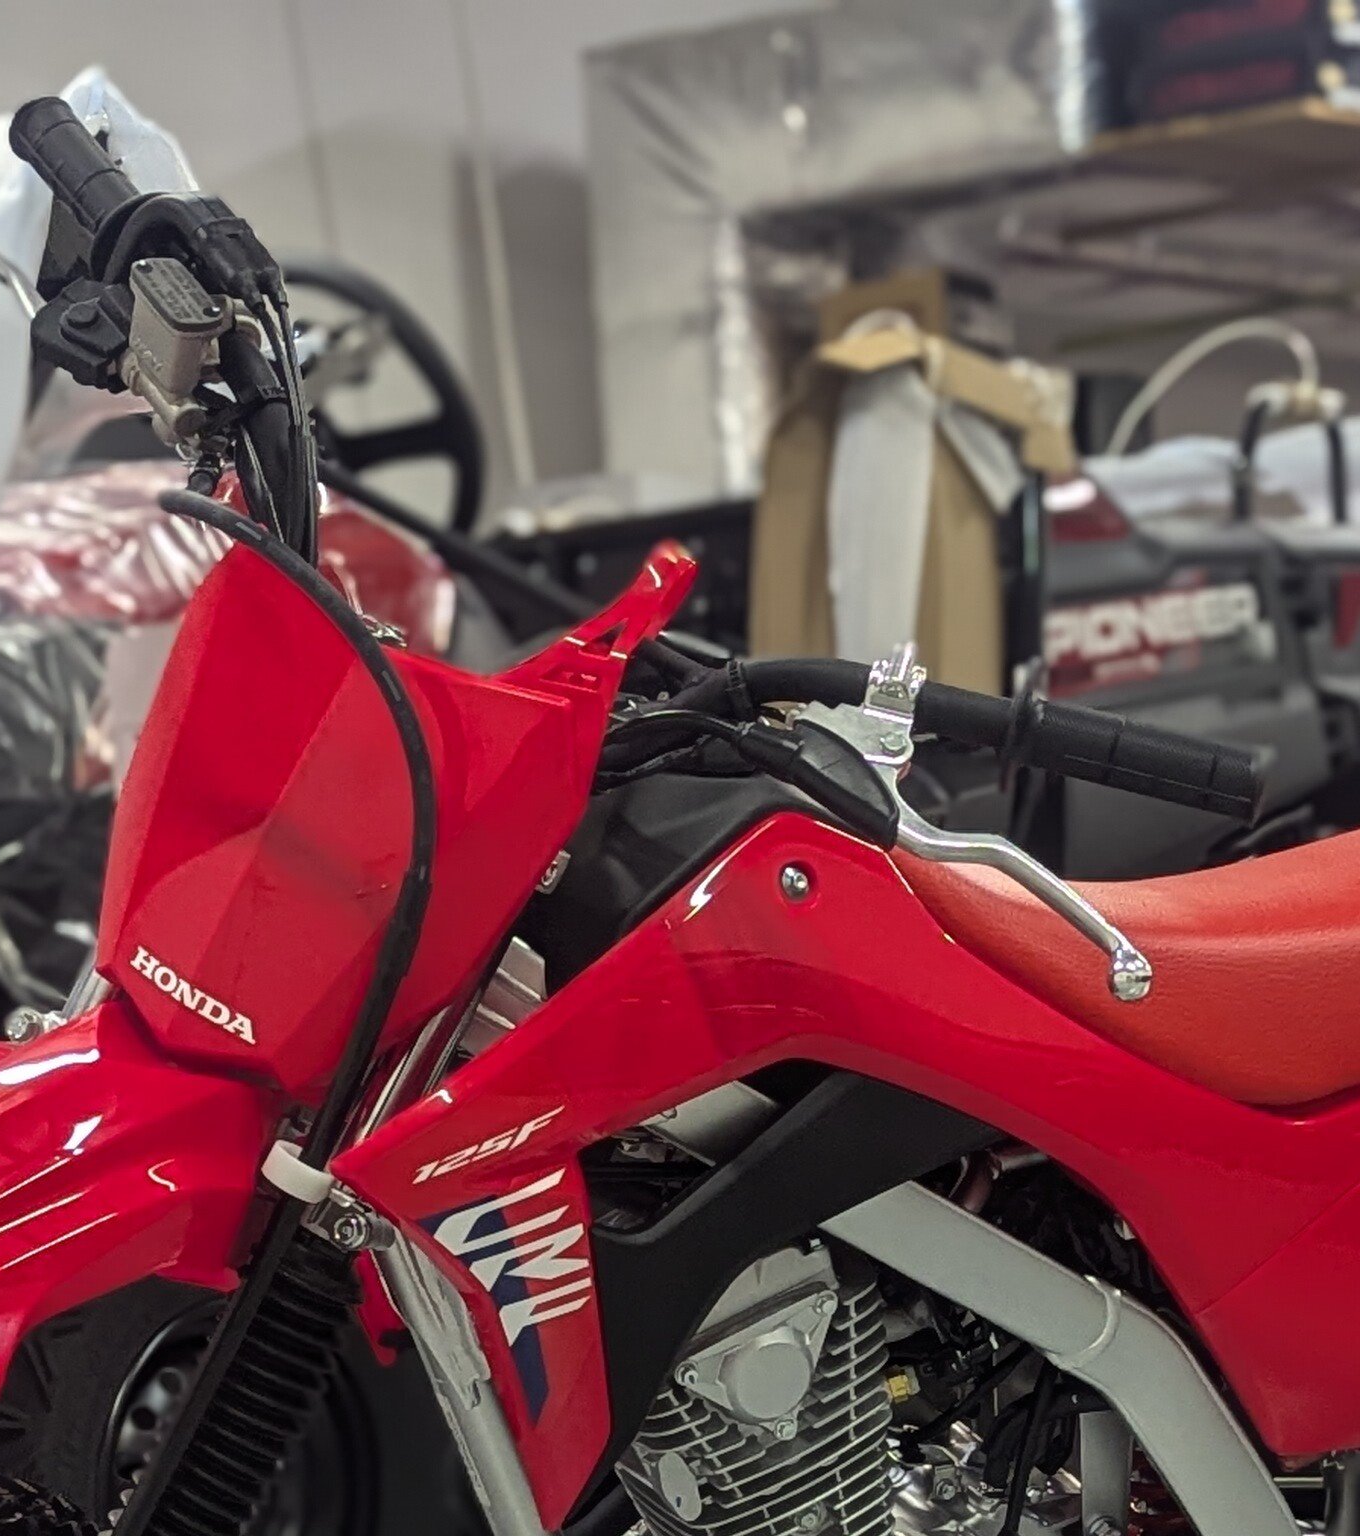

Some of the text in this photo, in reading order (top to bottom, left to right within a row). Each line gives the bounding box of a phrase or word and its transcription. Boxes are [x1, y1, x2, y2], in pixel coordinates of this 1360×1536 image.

[1043, 582, 1259, 666] PIONEER
[130, 945, 256, 1045] HONDA
[412, 1105, 566, 1185] 125F
